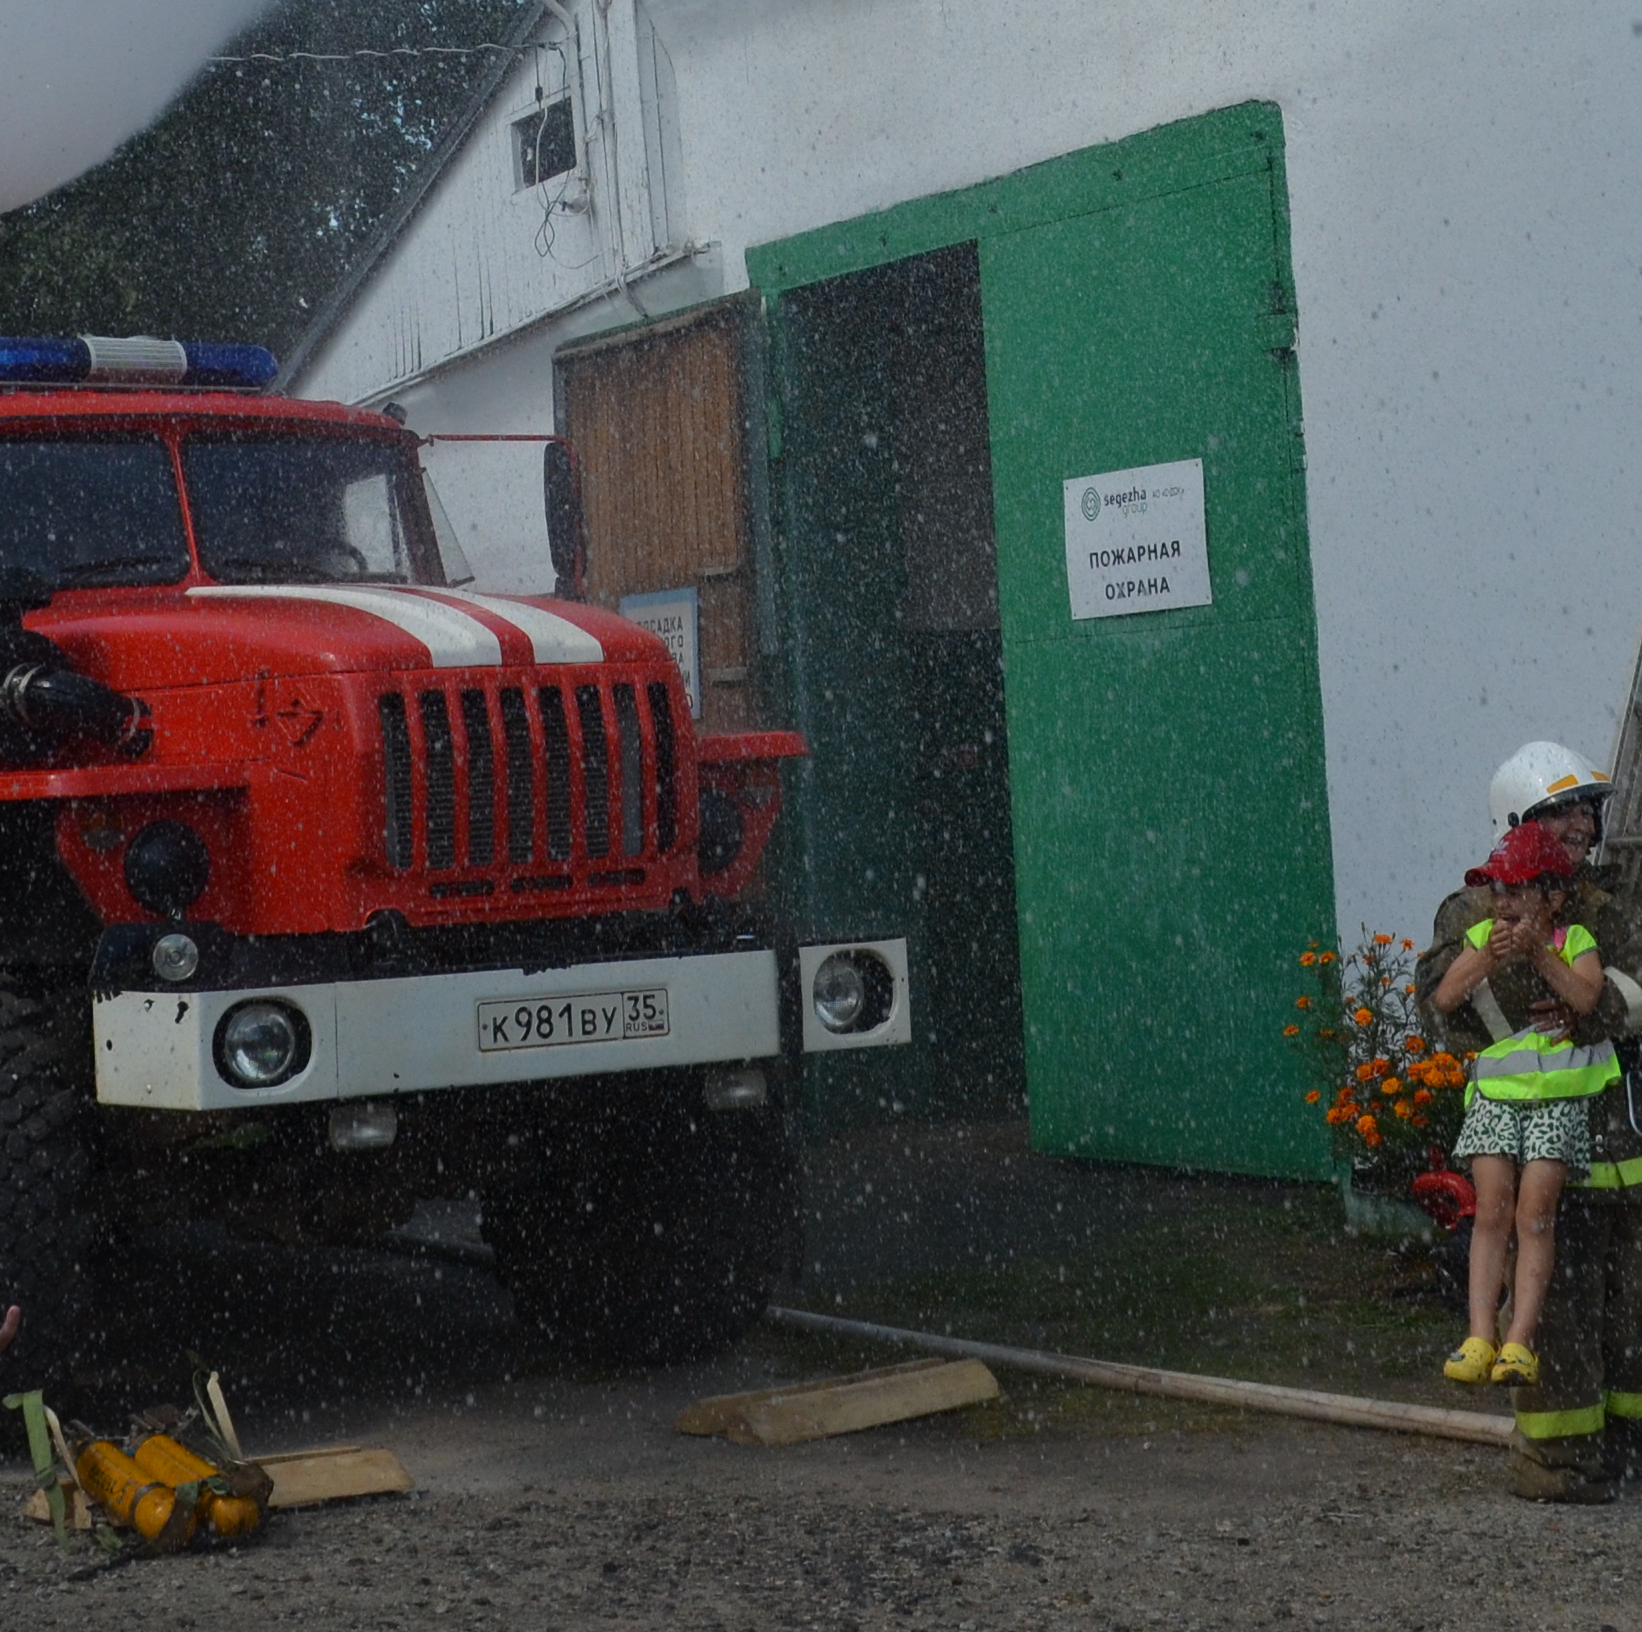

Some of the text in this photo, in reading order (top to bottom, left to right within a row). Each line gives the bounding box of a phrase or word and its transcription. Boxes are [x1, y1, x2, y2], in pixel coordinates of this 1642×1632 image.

[1104, 486, 1147, 508] segezha
[1089, 540, 1181, 569] ПОЖАРНАЯ
[1105, 576, 1171, 600] ОХРАНА
[626, 995, 657, 1021] 35
[625, 1021, 648, 1032] RUS
